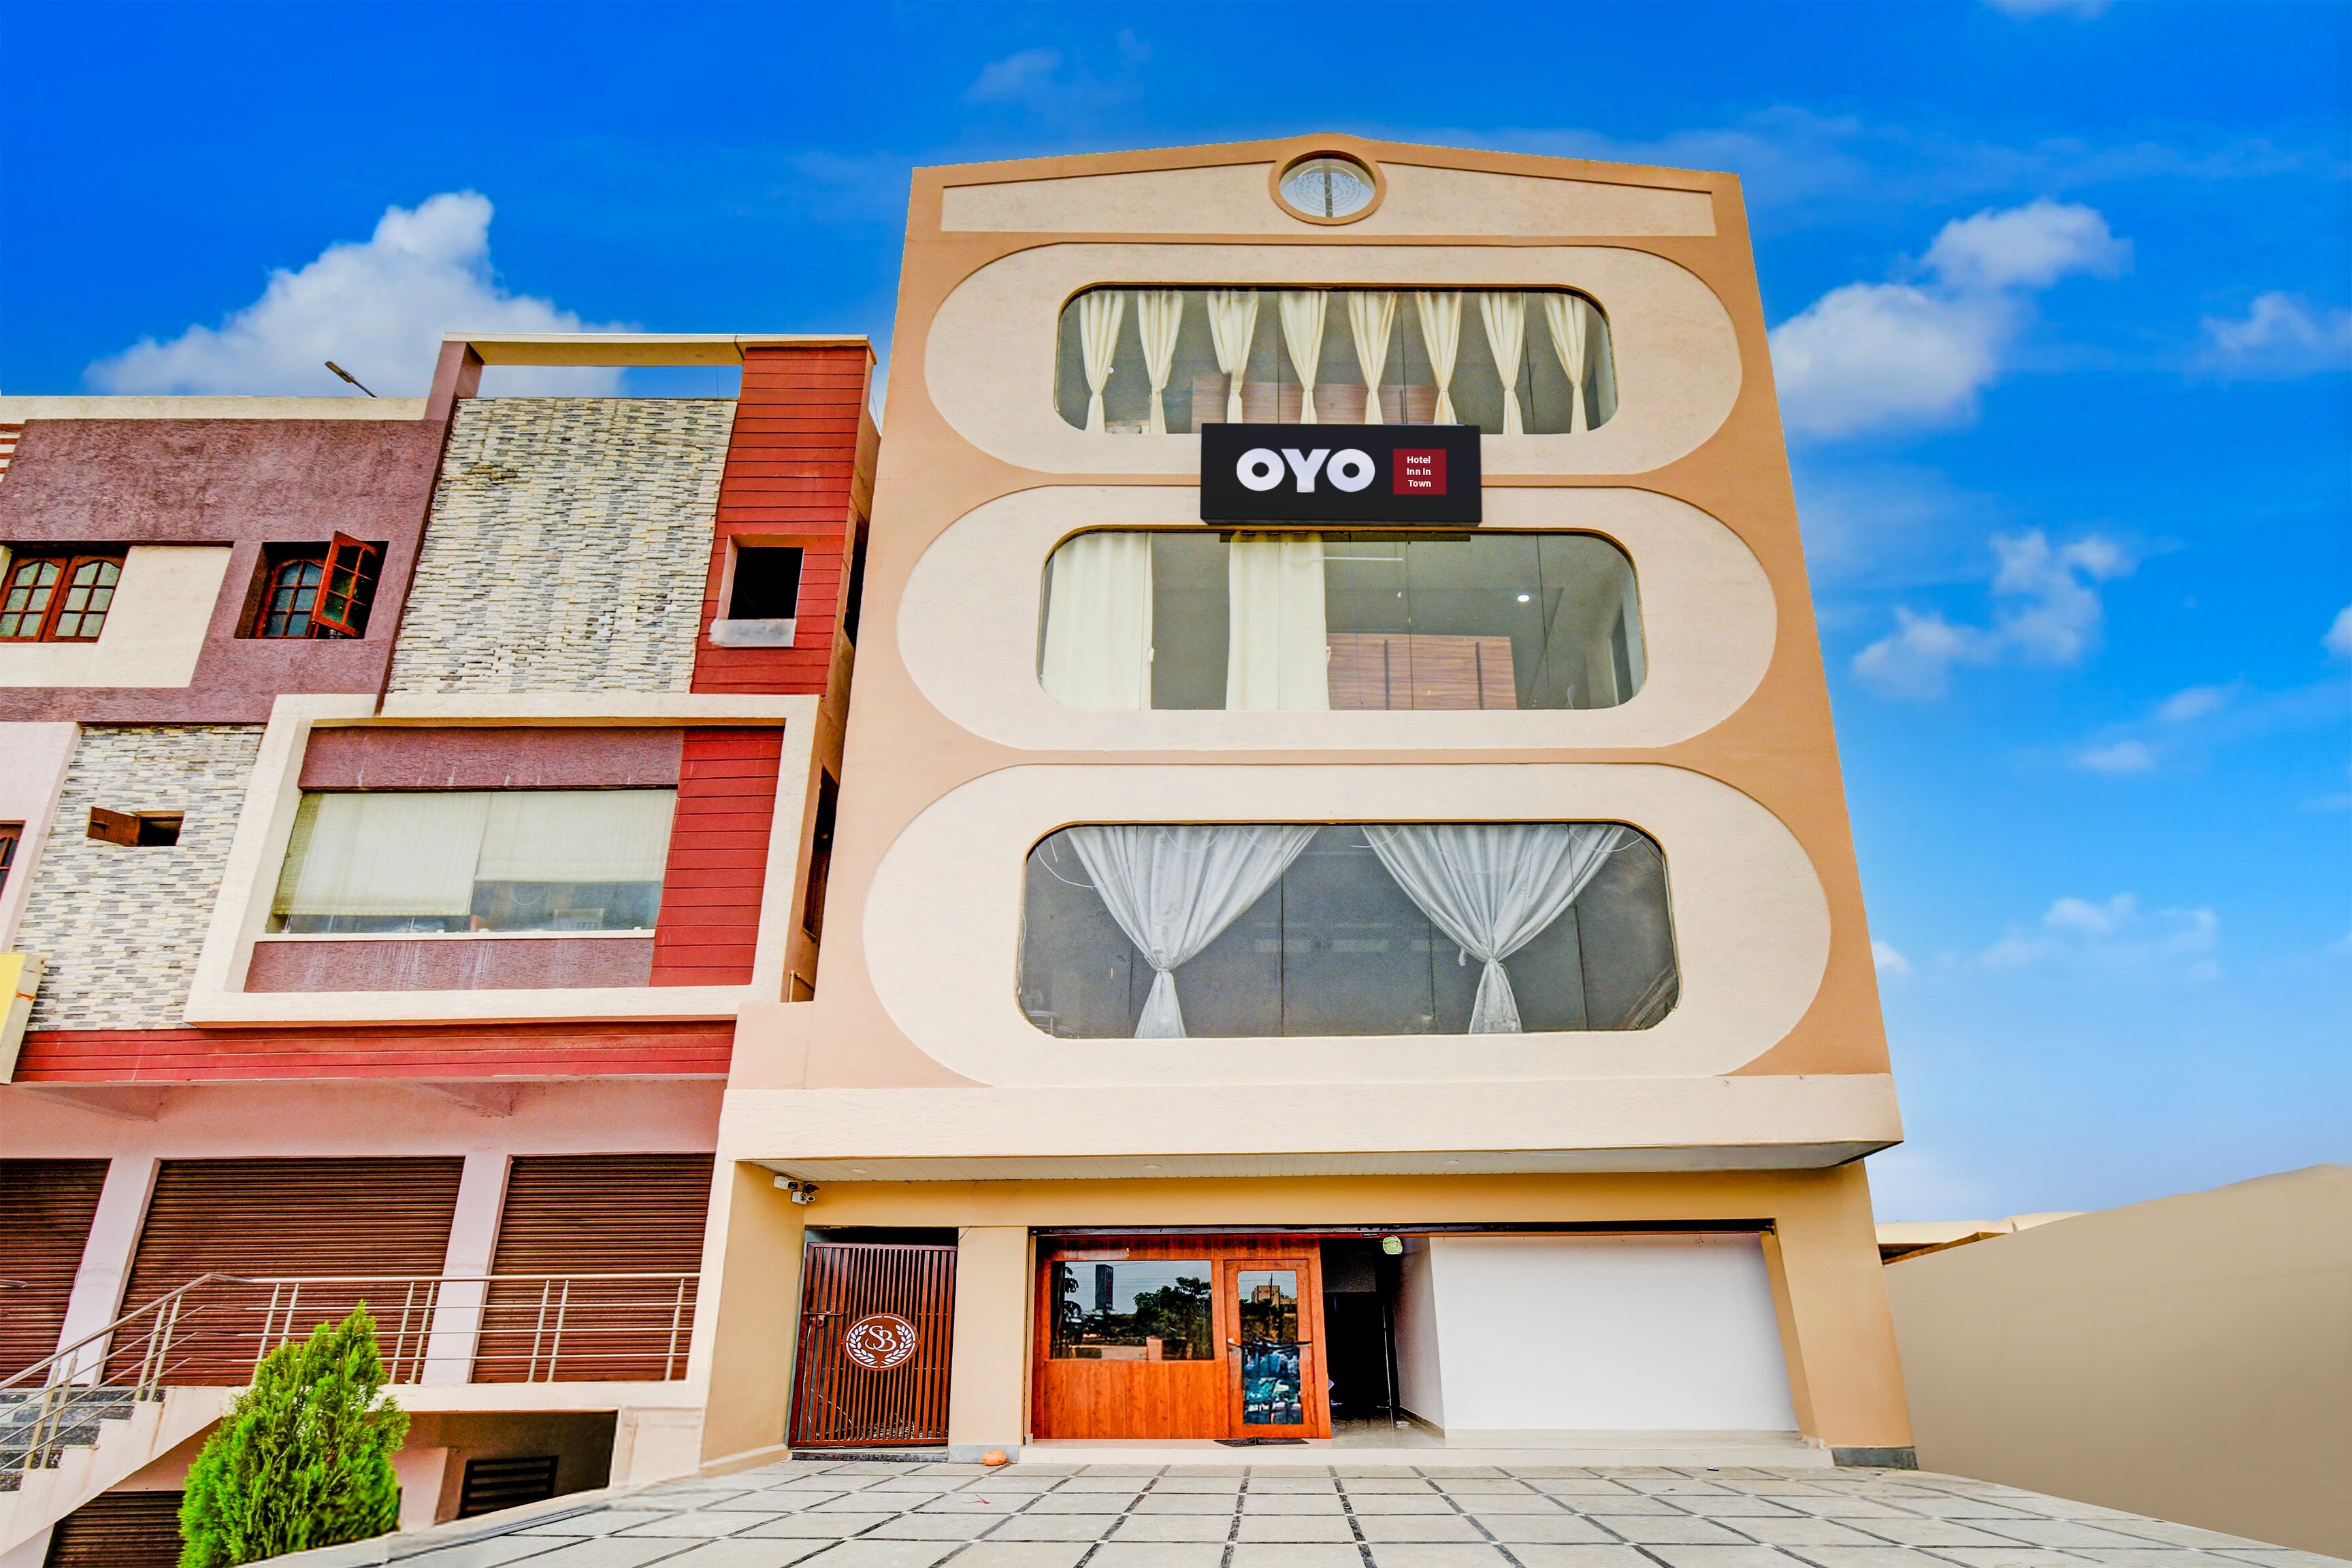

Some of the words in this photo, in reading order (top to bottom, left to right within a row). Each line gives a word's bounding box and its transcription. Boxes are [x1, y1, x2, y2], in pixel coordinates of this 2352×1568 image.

[1407, 455, 1431, 464] Hotel
[1236, 448, 1375, 493] OYO
[1407, 468, 1421, 476] Inn
[1422, 468, 1431, 476] In
[1407, 479, 1431, 487] Town
